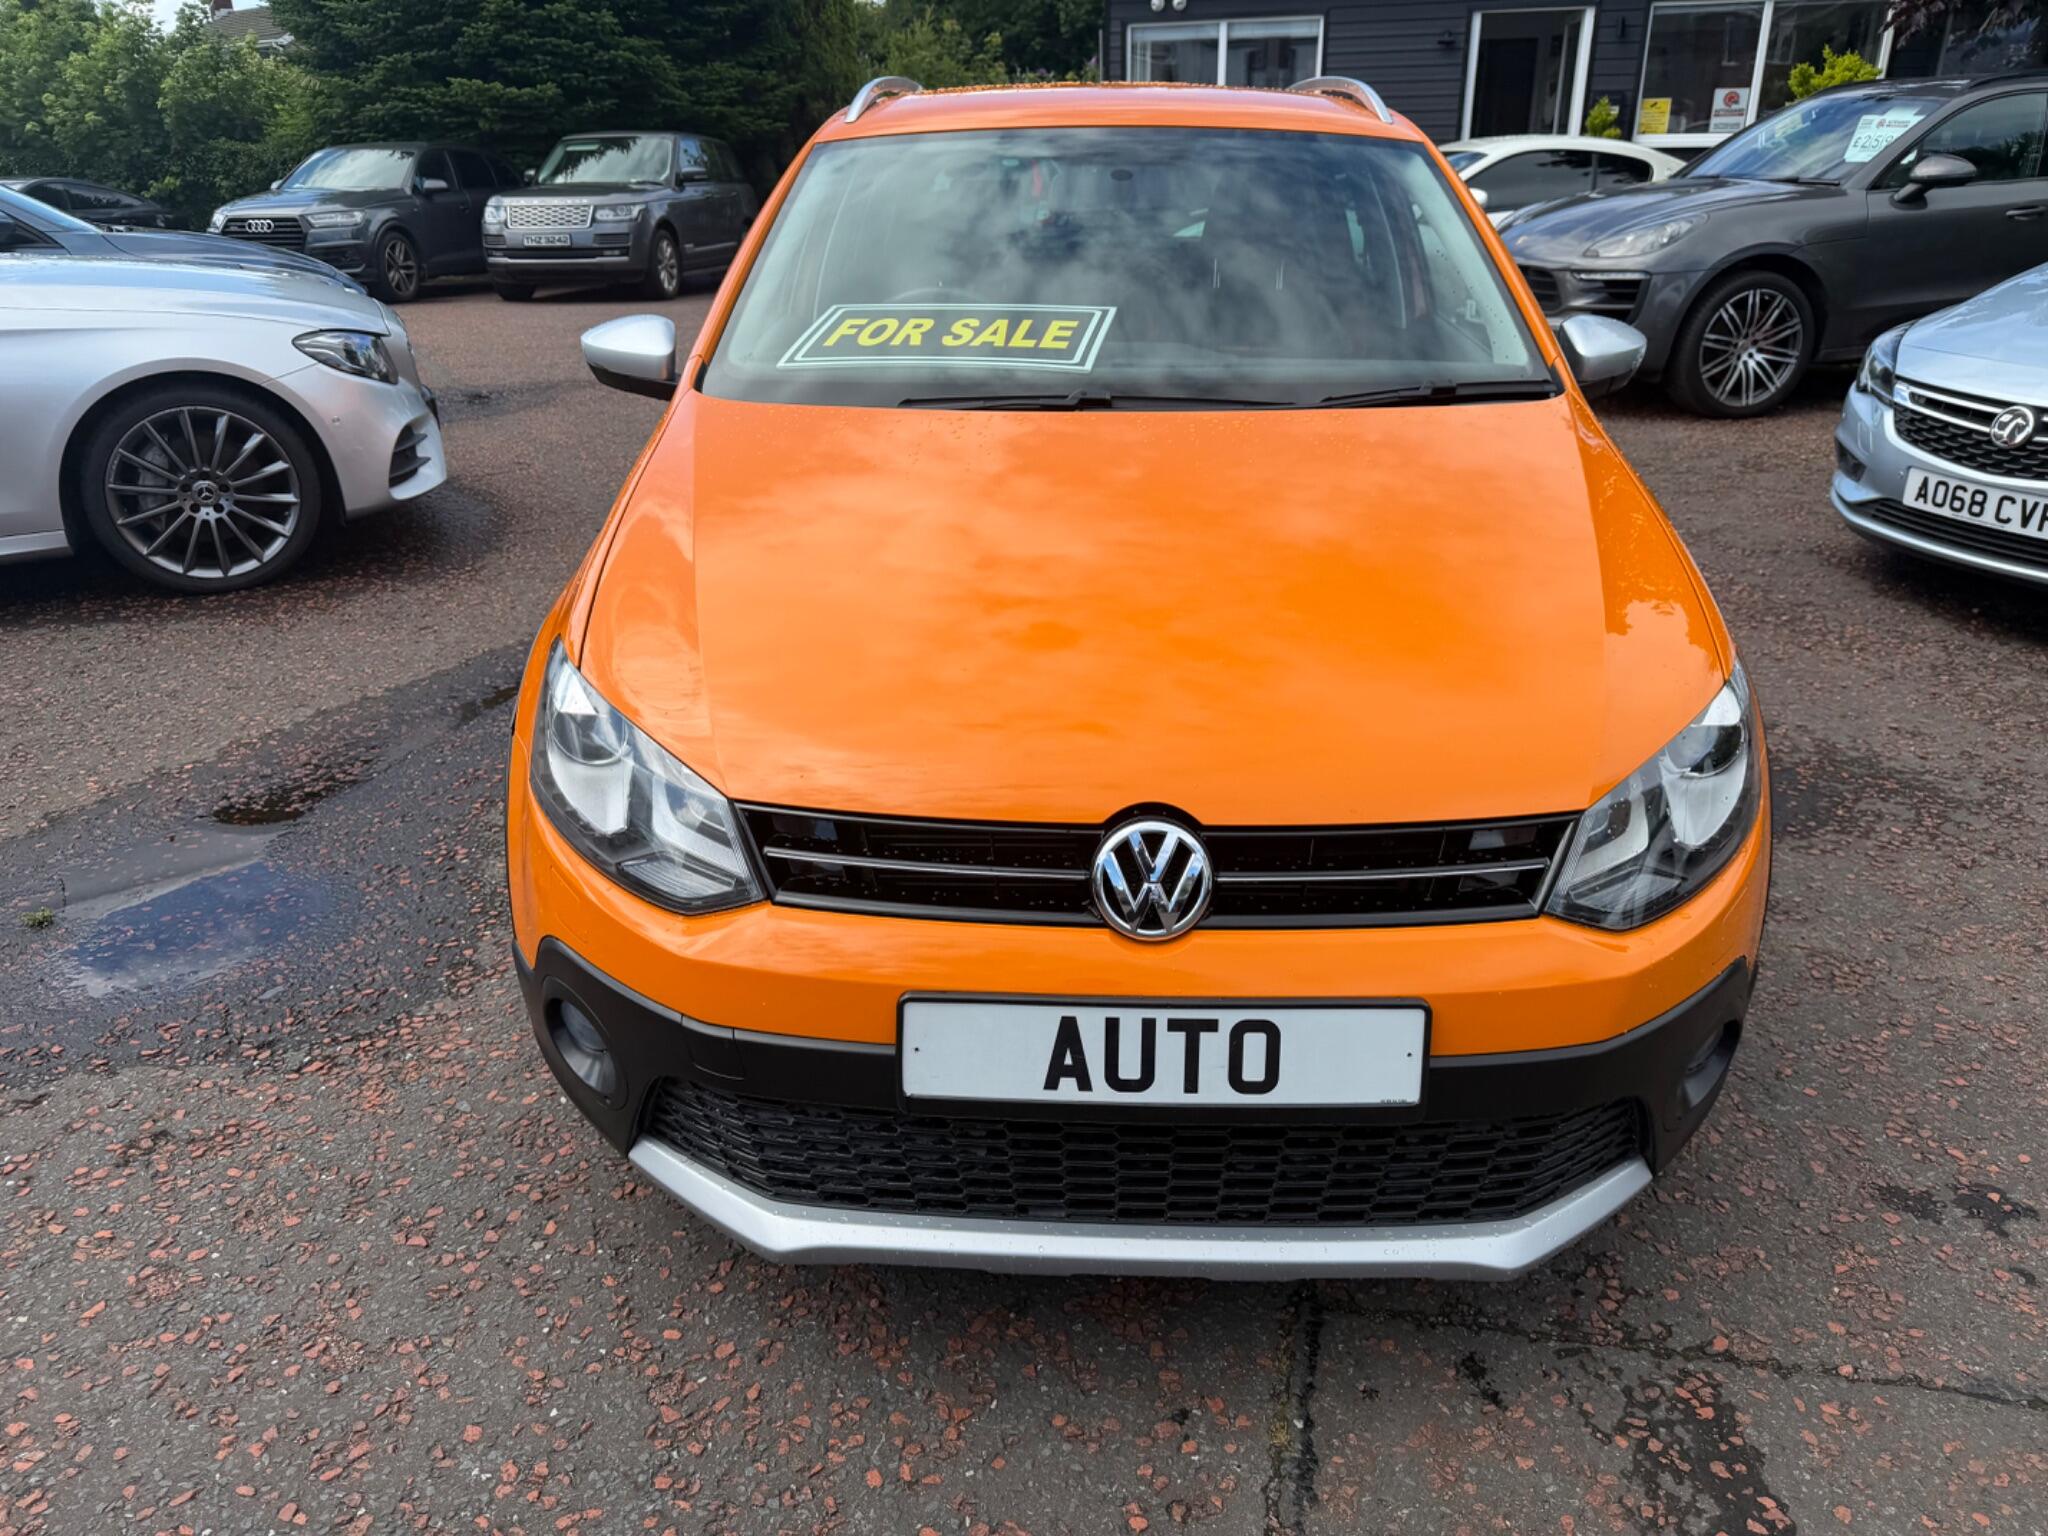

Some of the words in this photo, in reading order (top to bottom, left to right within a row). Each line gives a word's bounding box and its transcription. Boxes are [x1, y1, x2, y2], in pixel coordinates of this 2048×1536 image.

[823, 318, 934, 347] FOR
[942, 319, 1079, 349] SALE
[1043, 1015, 1281, 1095] AUTO
